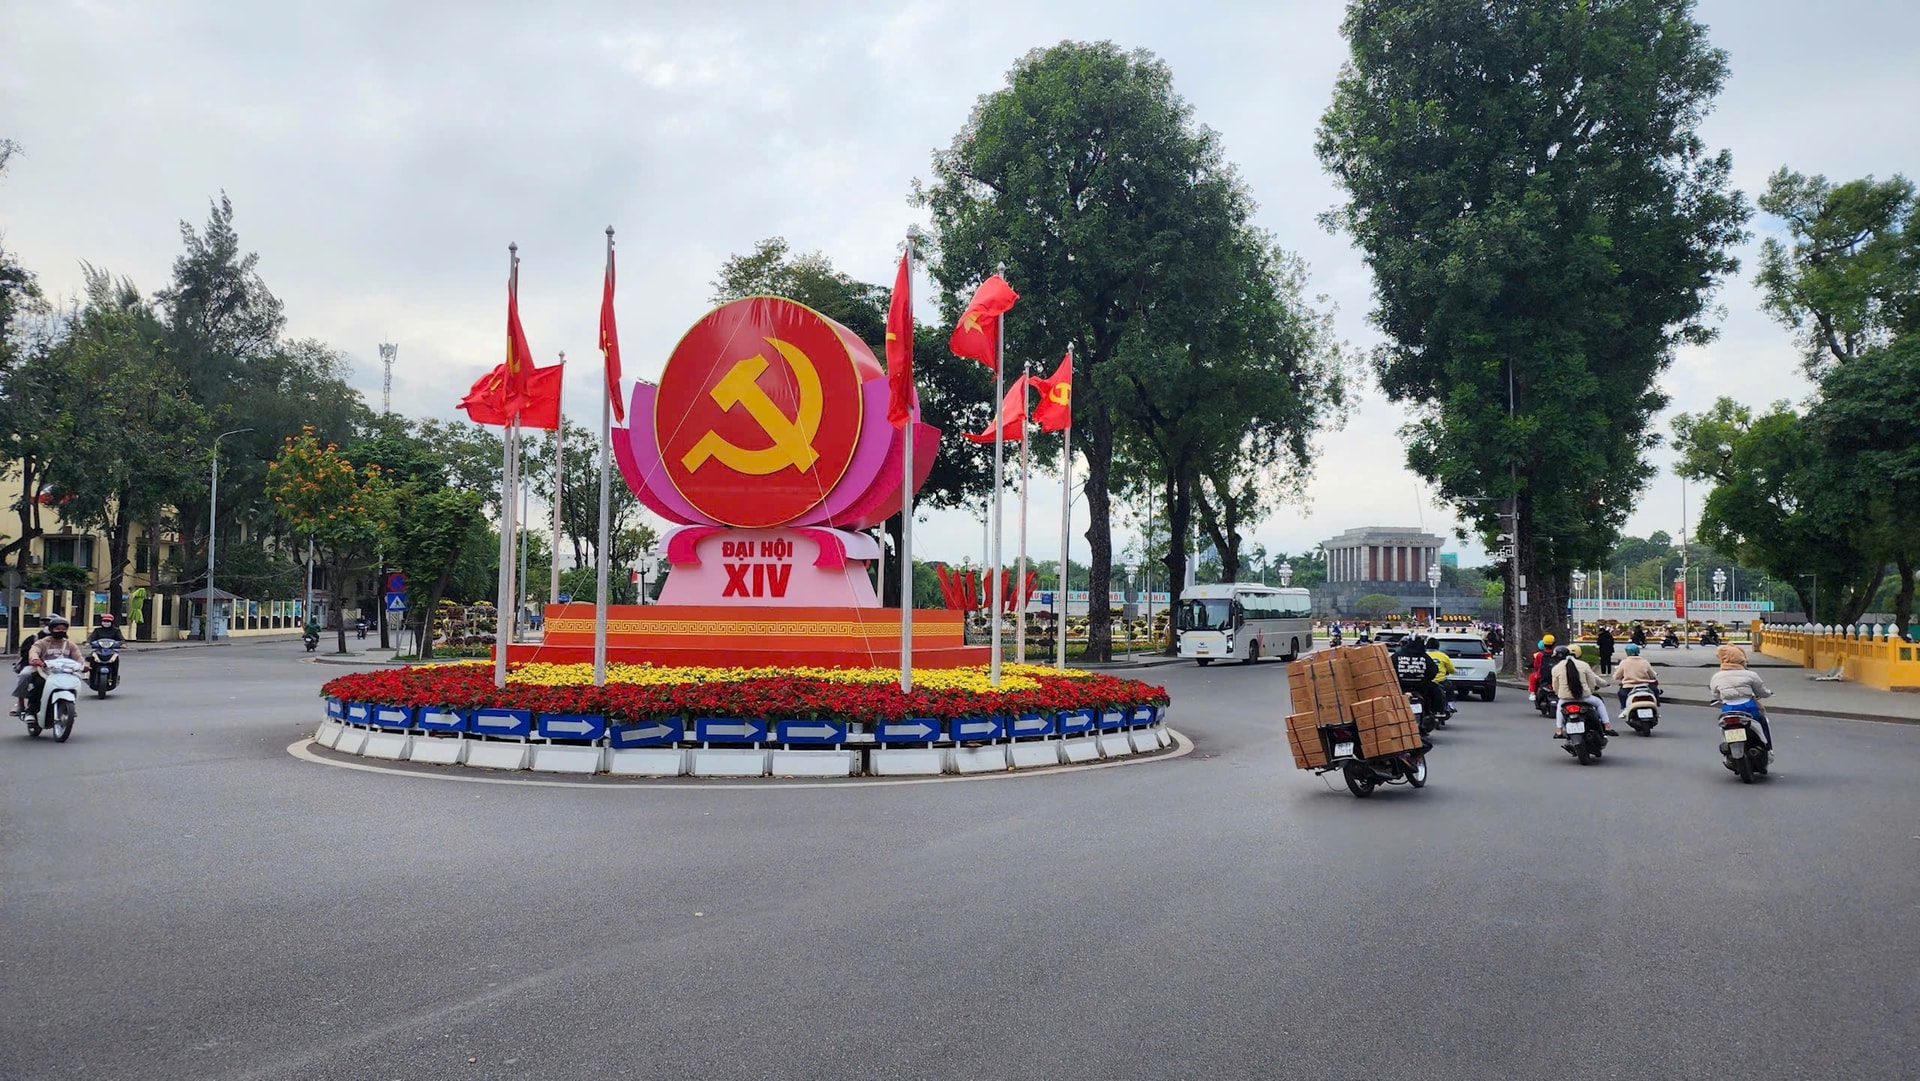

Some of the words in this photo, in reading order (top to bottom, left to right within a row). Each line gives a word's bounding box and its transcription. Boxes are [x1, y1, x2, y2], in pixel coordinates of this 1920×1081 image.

[722, 541, 754, 561] ĐẠI
[761, 537, 793, 561] HỘI
[722, 564, 792, 597] XIV
